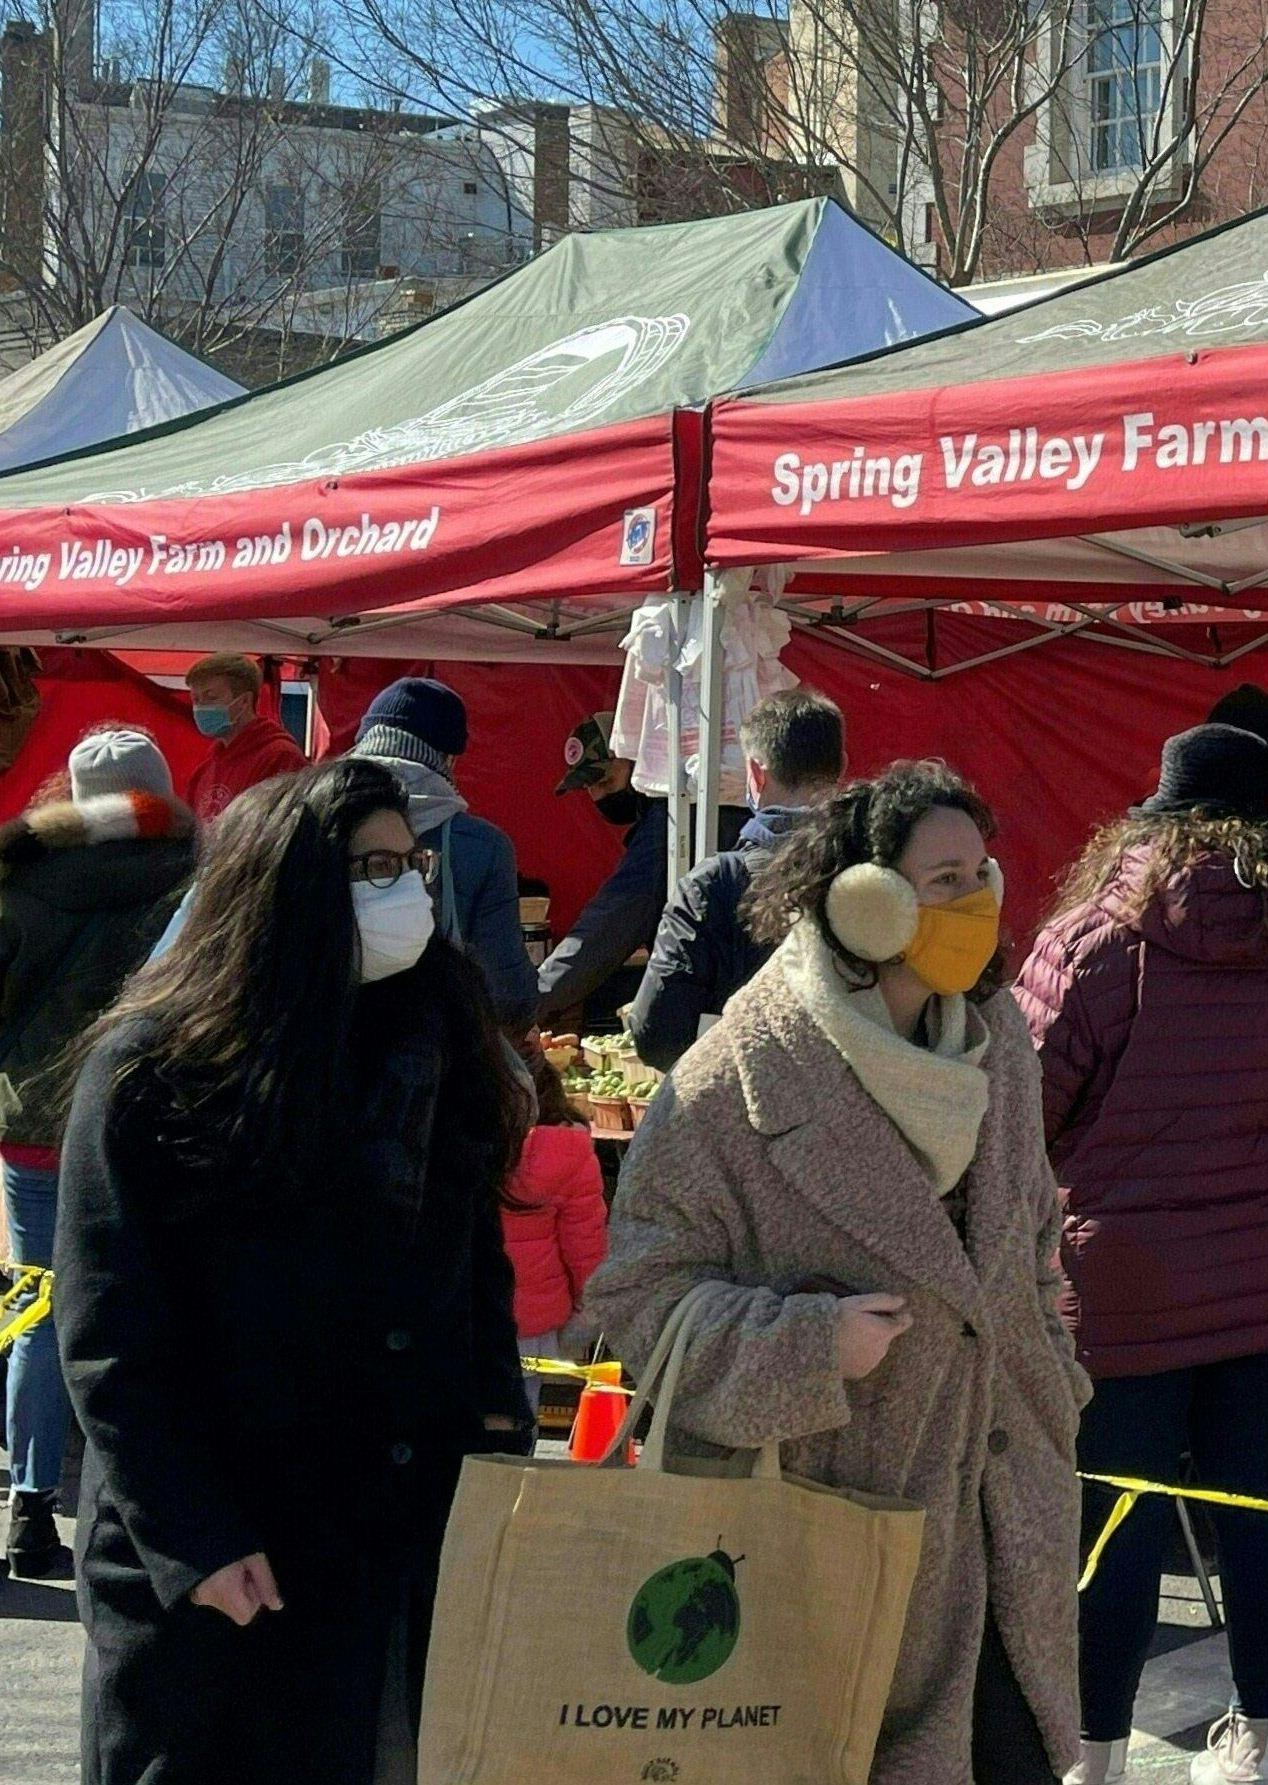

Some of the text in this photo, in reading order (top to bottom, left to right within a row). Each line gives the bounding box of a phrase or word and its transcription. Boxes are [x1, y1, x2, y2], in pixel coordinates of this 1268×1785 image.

[771, 446, 923, 516] Spring
[940, 426, 1105, 490] Valley
[57, 539, 144, 587] Valley
[147, 533, 226, 576] Farm
[231, 522, 293, 570] and
[300, 507, 440, 562] Orchard
[559, 1703, 782, 1730] I LOVE MY PLANET
